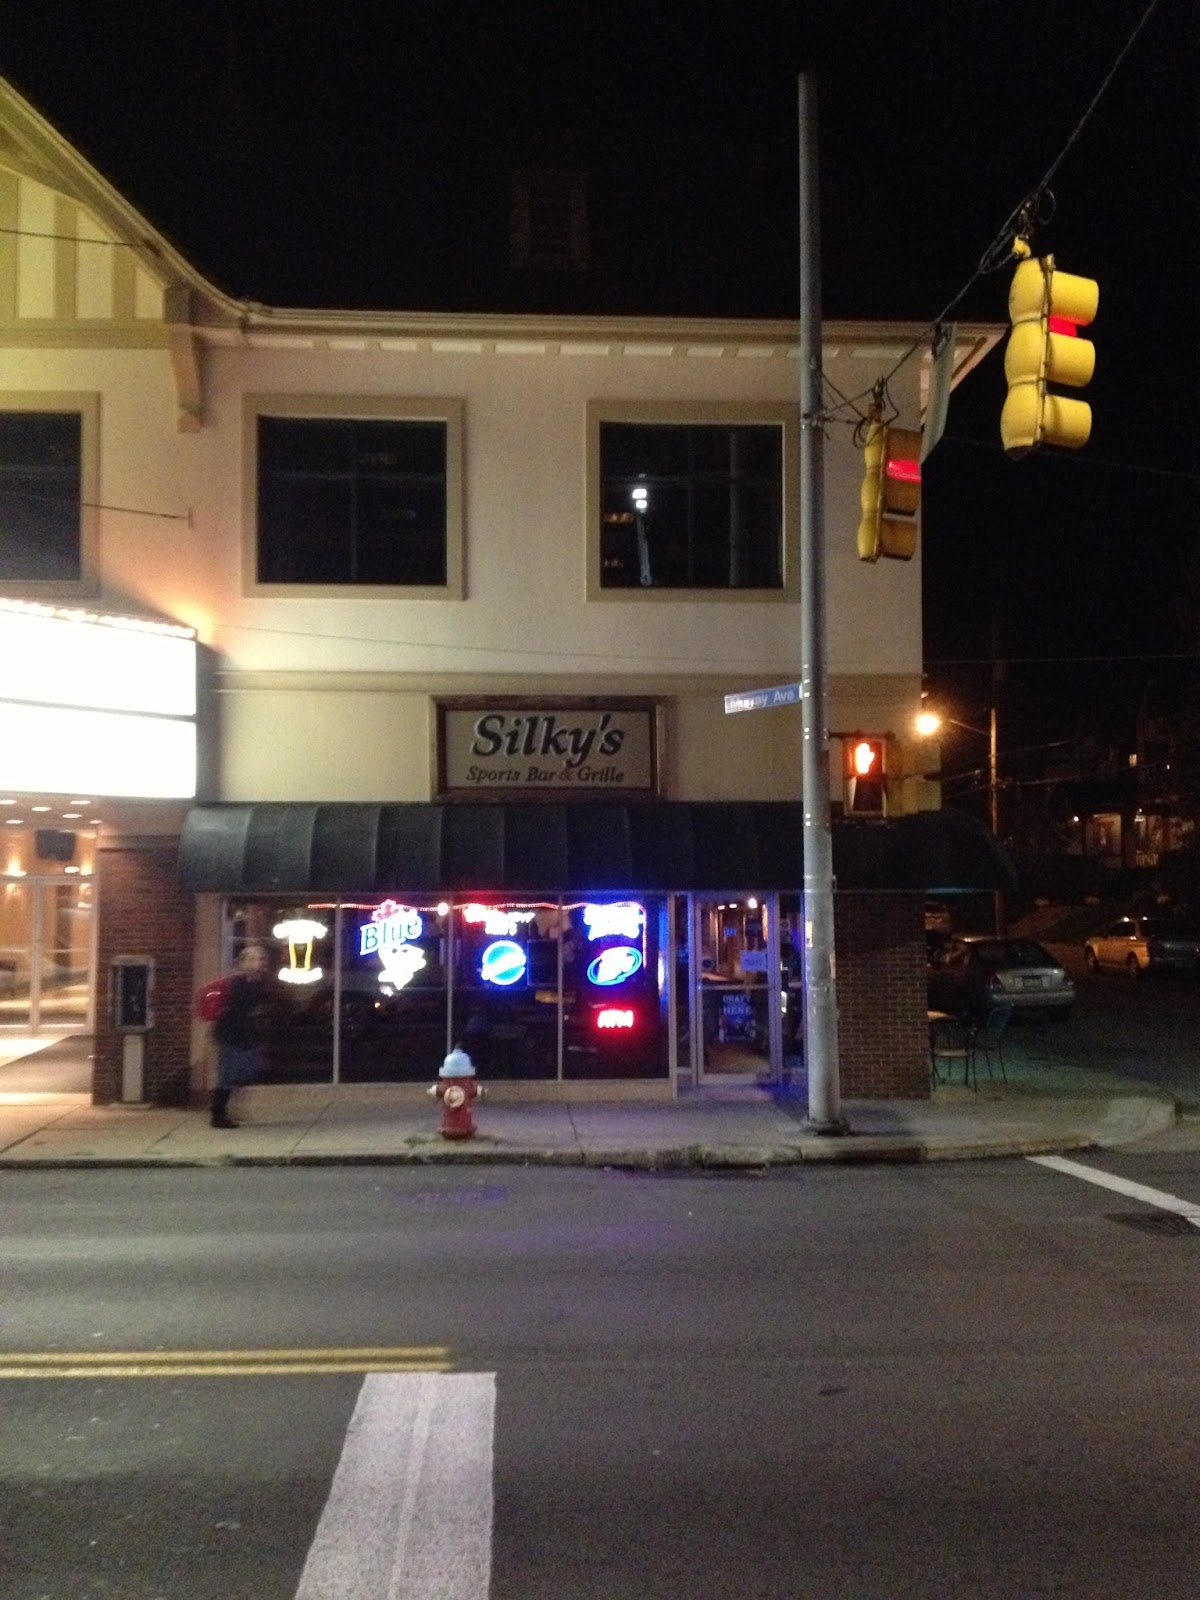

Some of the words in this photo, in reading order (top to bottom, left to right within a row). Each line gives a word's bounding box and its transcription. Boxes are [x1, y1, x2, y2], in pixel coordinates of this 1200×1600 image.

[774, 690, 794, 703] Ave
[472, 713, 625, 768] Silky's
[466, 766, 520, 784] Sports
[526, 767, 557, 782] Bar
[558, 767, 575, 782] &
[577, 766, 624, 783] Grille
[360, 911, 422, 955] Blue
